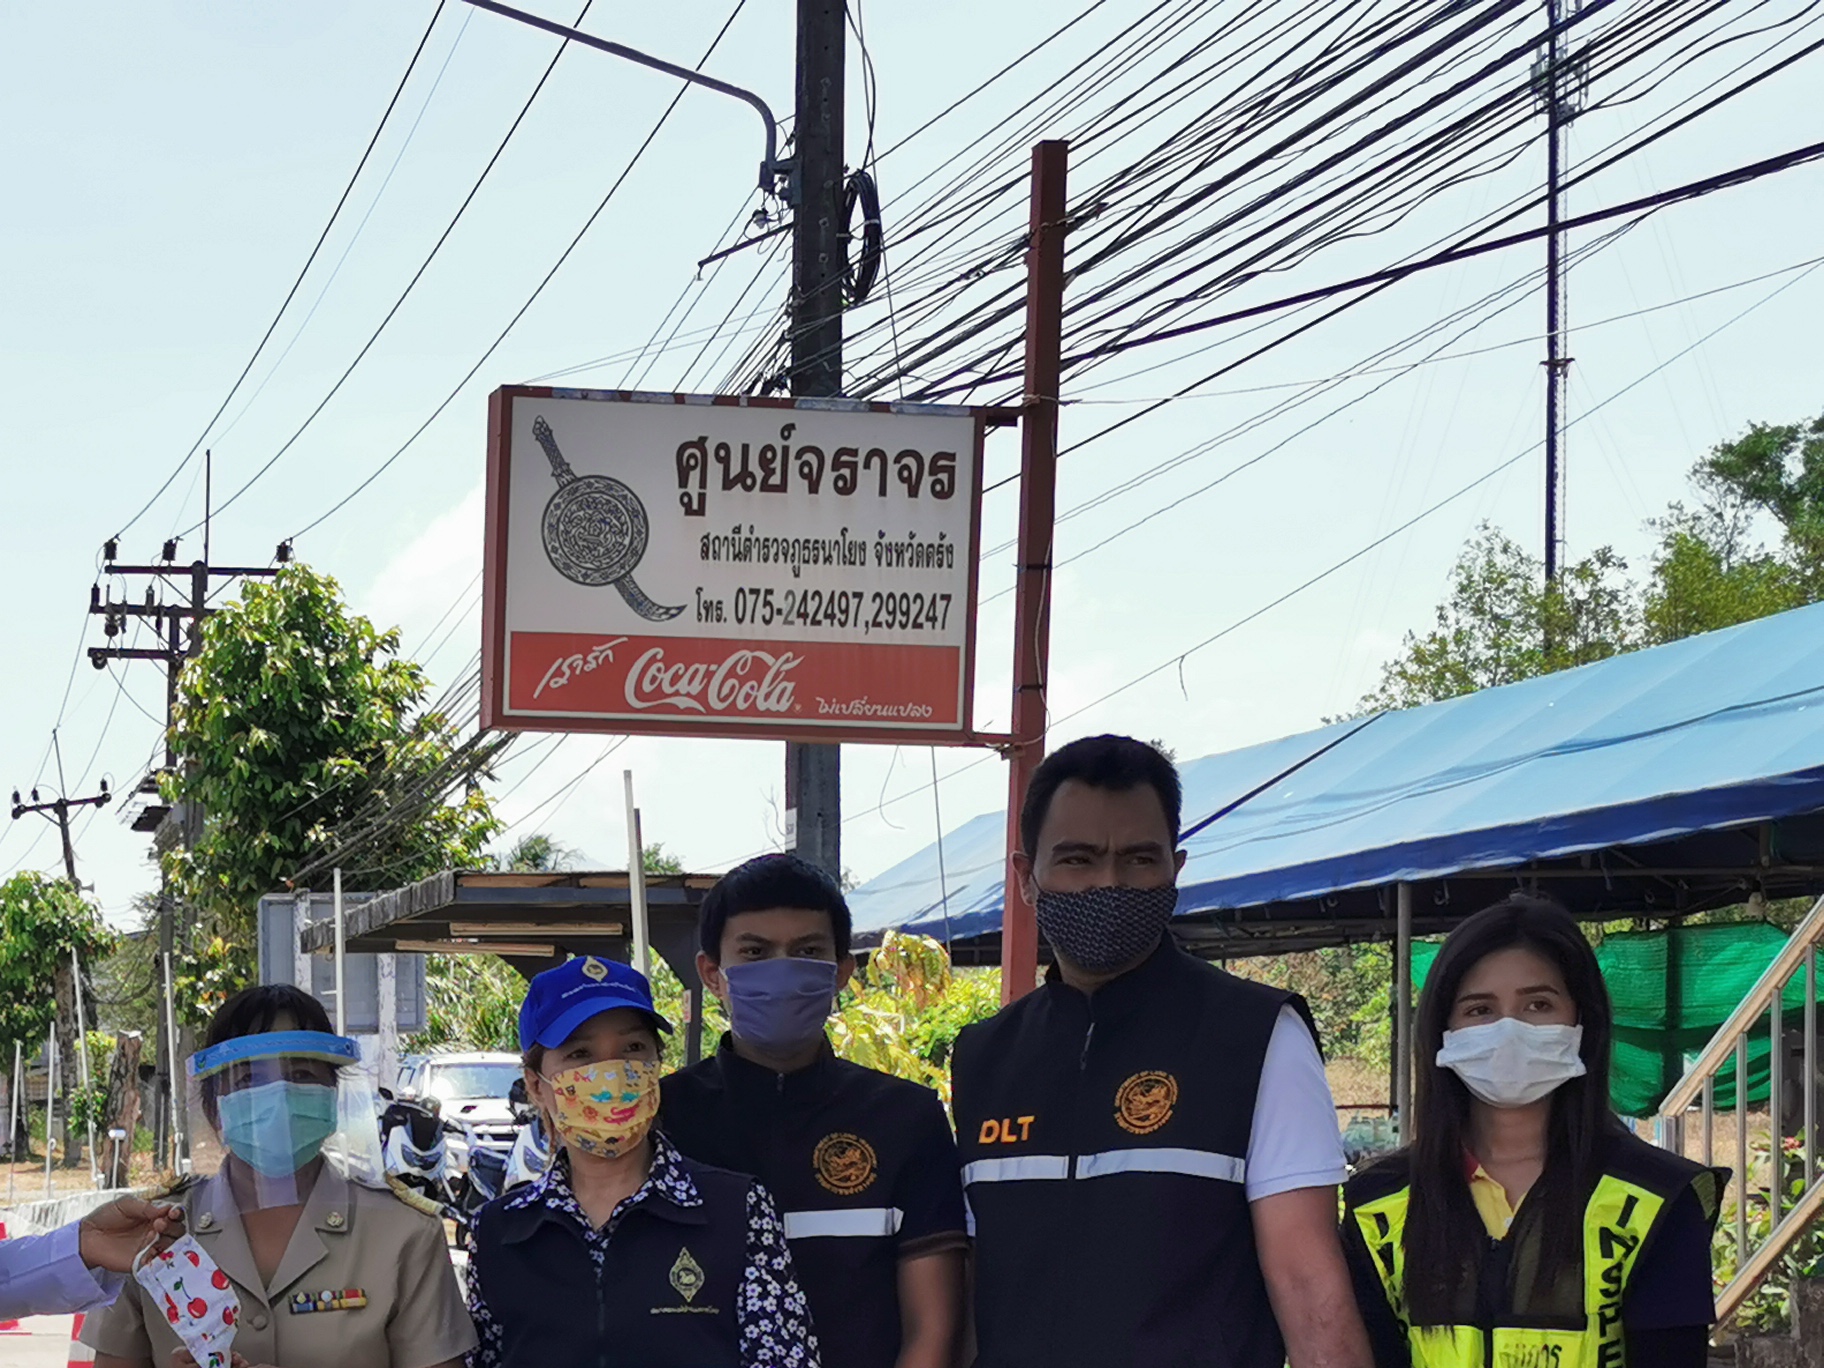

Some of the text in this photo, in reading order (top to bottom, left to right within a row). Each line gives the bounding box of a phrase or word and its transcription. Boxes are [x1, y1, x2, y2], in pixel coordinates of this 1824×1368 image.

[675, 422, 957, 517] ศูนย์จราจร
[700, 523, 955, 578] สถานีตำรวจภูธรนาโยง จังหวัดตรัง
[695, 587, 953, 635] โทร. 075-242497,299247
[533, 636, 629, 699] เรารัก
[625, 646, 806, 713] Coca-Cola
[978, 1115, 1035, 1144] DLT
